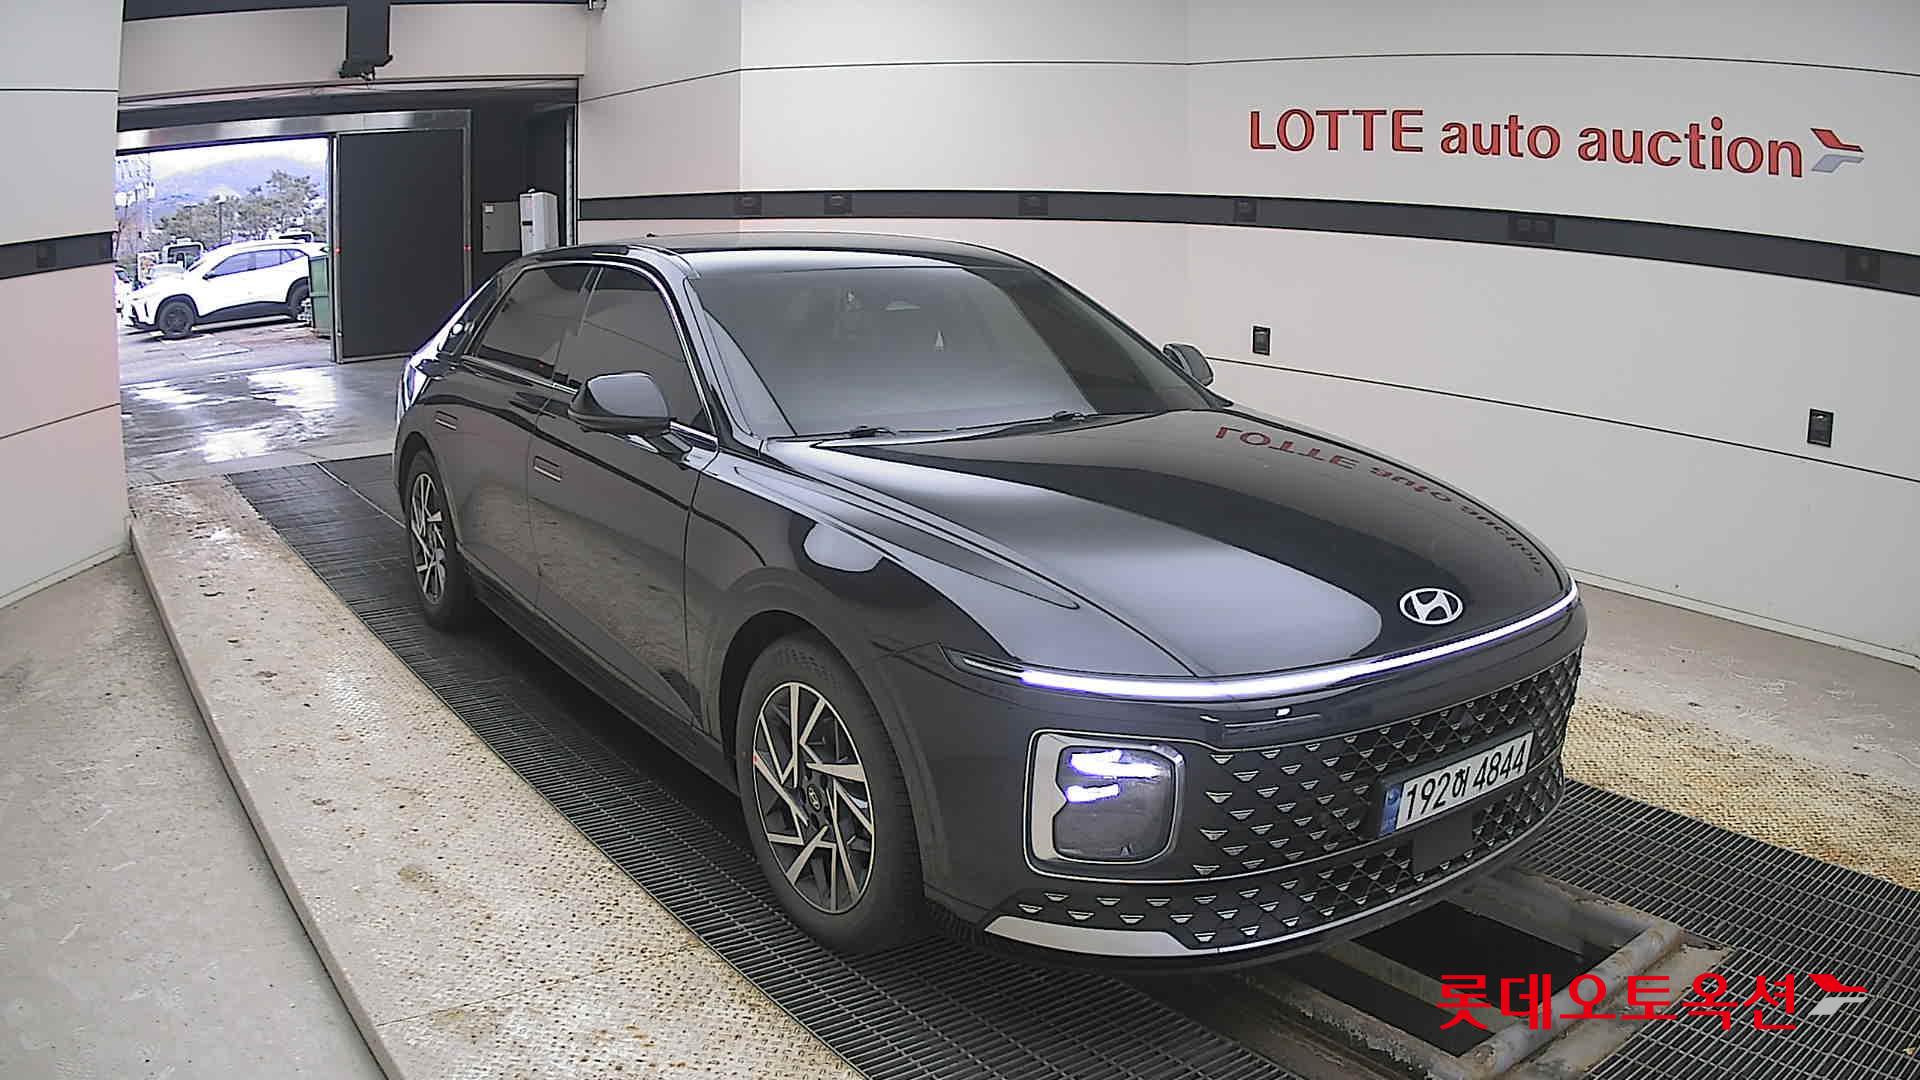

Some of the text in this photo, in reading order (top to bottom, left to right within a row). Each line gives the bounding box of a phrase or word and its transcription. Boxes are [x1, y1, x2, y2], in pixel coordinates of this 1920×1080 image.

[1249, 109, 1803, 178] LOTTE auto auction
[1472, 739, 1528, 791] 4844
